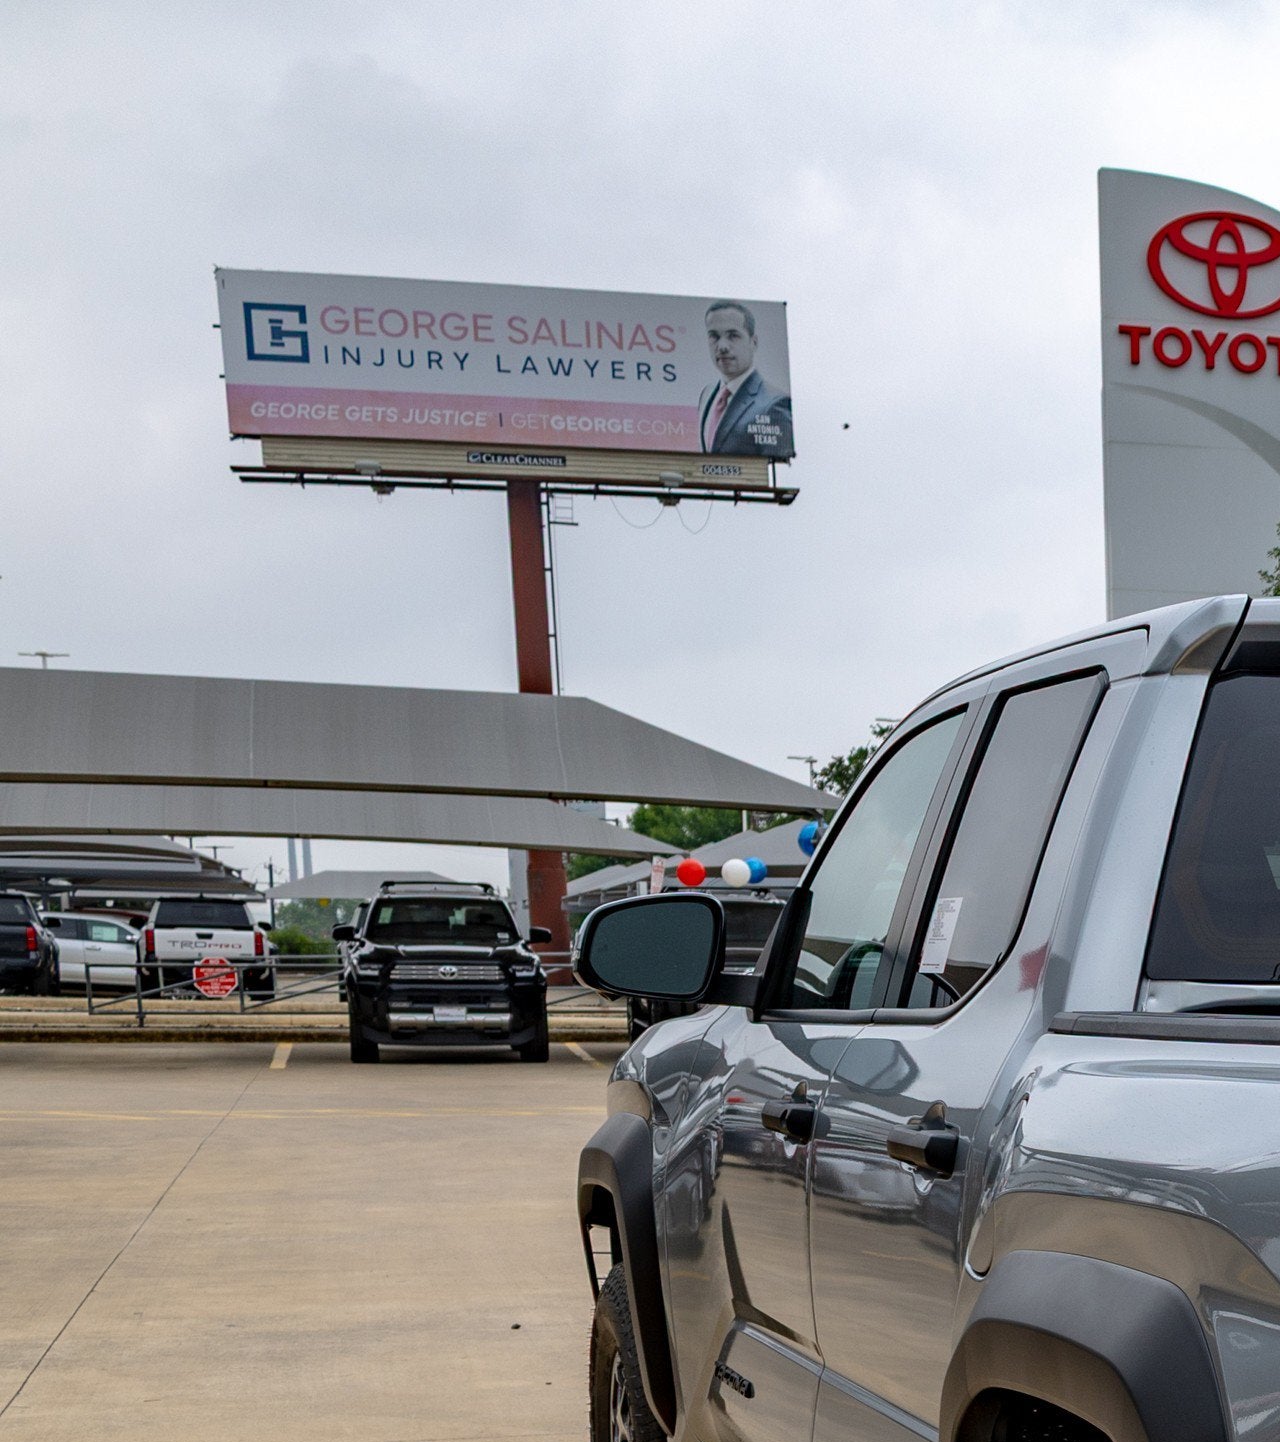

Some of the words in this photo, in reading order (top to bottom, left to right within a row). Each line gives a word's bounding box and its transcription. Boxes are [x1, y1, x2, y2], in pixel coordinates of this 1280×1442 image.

[320, 305, 495, 343] GEORGE
[323, 345, 470, 371] INJURY
[496, 354, 678, 382] LAWYERS
[251, 402, 339, 420] GEORGE
[345, 406, 398, 423] GETS
[403, 408, 488, 427] JUSTICE
[511, 412, 685, 435] GETGEORGE.COM
[755, 415, 771, 424] SAN
[754, 434, 777, 445] TEXAS
